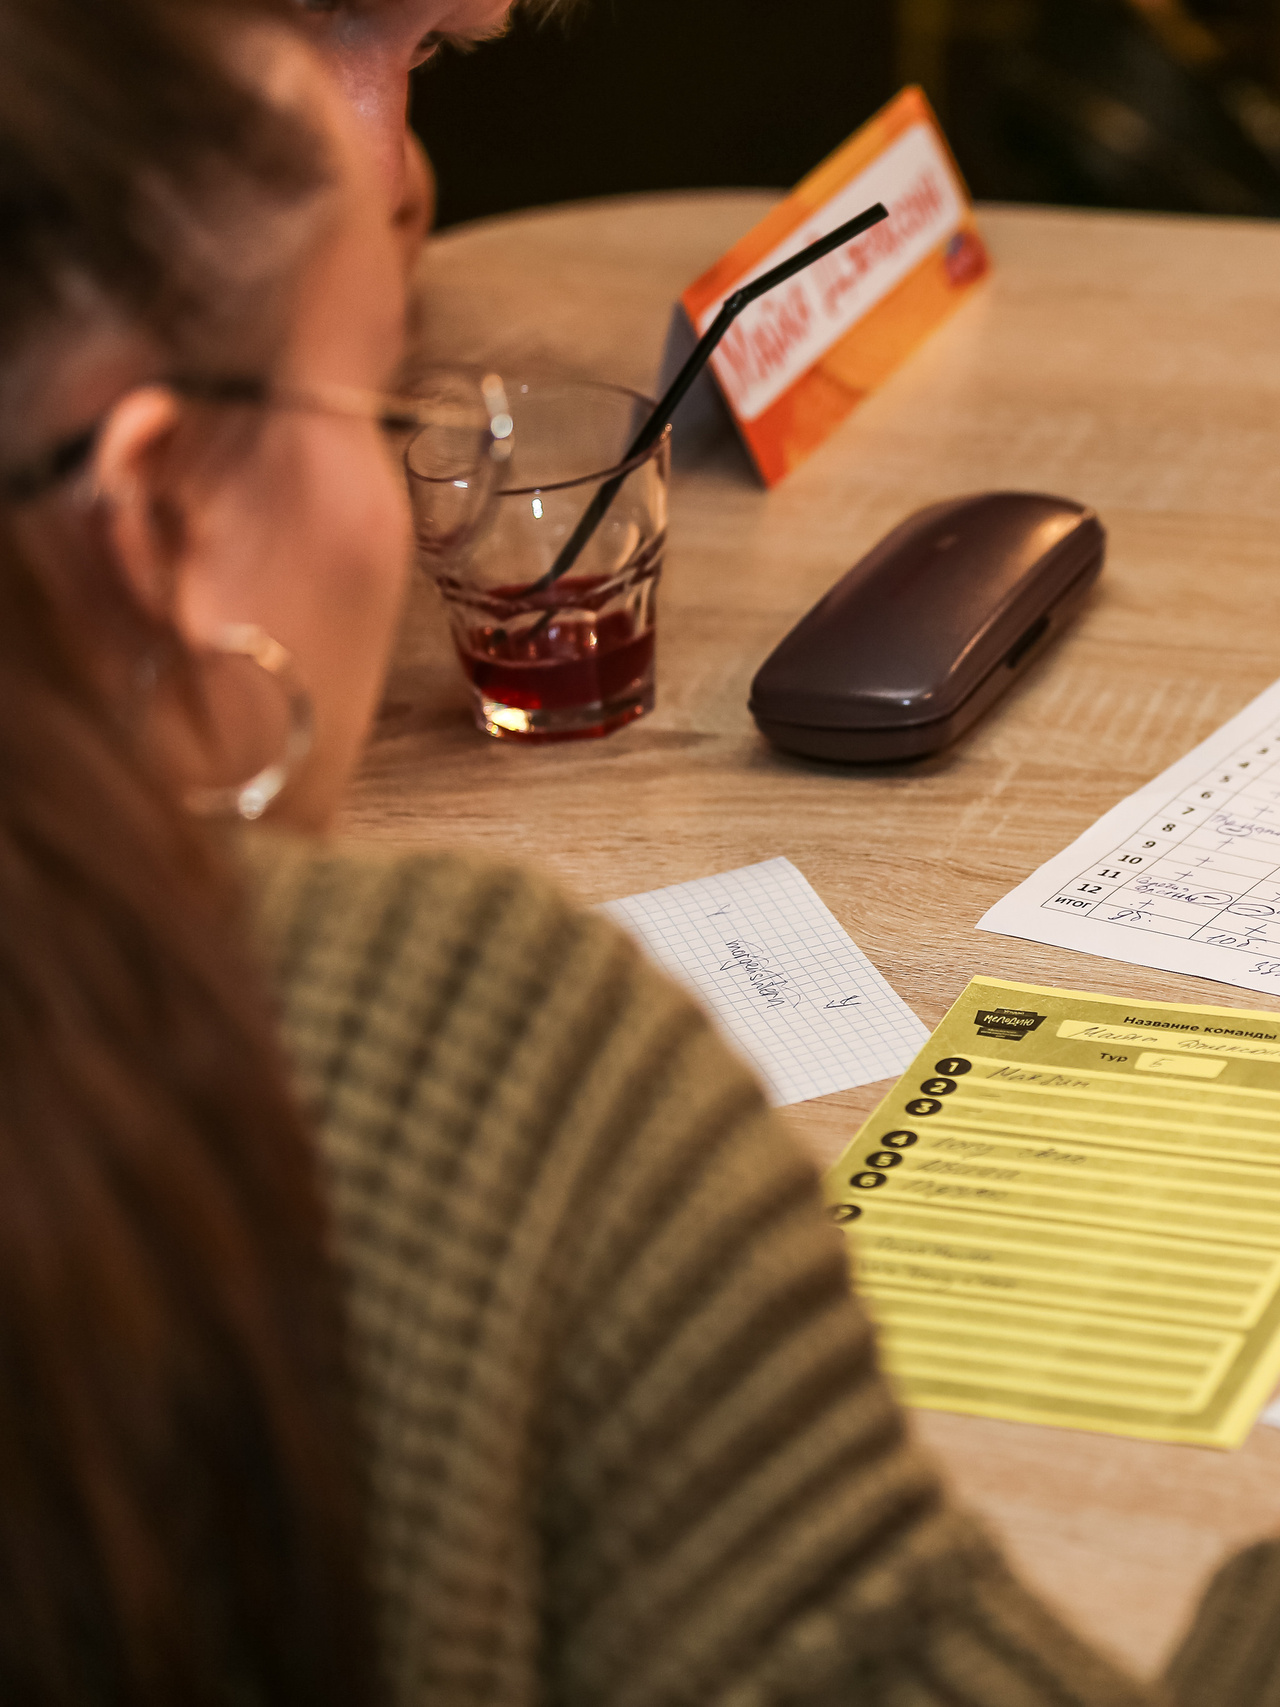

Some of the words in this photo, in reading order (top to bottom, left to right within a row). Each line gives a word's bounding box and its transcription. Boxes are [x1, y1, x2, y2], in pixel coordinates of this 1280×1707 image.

[1200, 790, 1214, 800] 6
[1181, 806, 1195, 816] 7
[1161, 822, 1176, 833] 8
[1141, 839, 1156, 850] 9
[1117, 853, 1143, 865] 10
[1097, 868, 1121, 880] 11
[1076, 882, 1103, 895] 12
[1053, 896, 1093, 909] ИТОГ
[1122, 1015, 1200, 1033] Название
[1202, 1026, 1279, 1041] команды
[1099, 1051, 1129, 1064] Тур
[930, 1081, 947, 1094] 2
[915, 1101, 933, 1114] 3
[891, 1133, 908, 1146] 4
[875, 1155, 893, 1167] 5
[859, 1175, 878, 1187] 6
